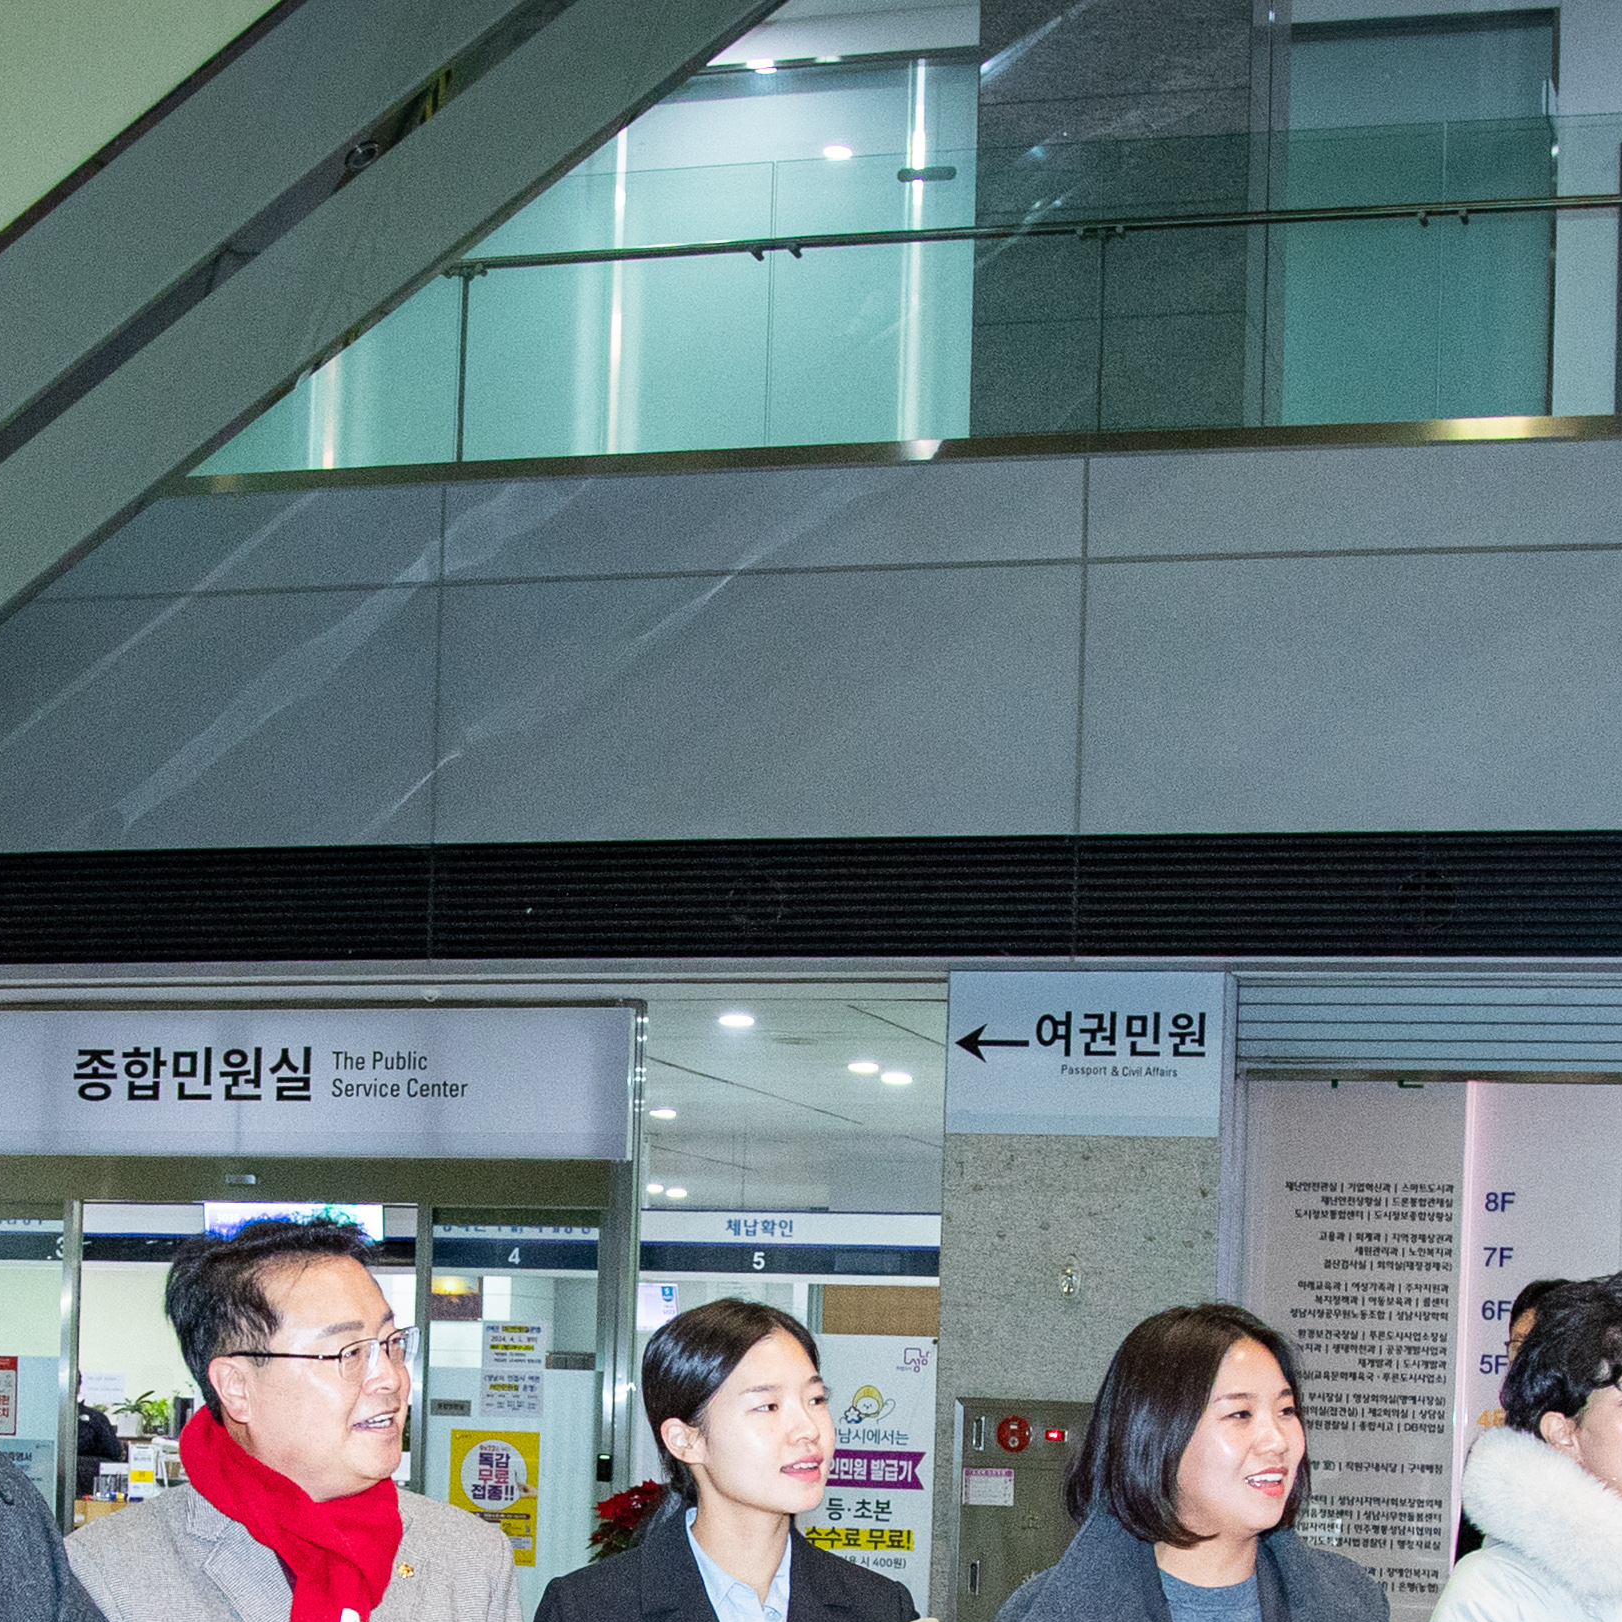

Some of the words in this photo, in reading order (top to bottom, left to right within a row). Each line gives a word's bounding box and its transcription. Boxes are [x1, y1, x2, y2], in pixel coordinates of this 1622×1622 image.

[1035, 1010, 1206, 1057] 여권민원
[332, 1050, 364, 1071] The
[371, 1050, 429, 1072] Public
[1061, 1064, 1107, 1077] Passport
[1110, 1066, 1119, 1076] &
[1122, 1066, 1142, 1077] Civil
[1145, 1066, 1178, 1078] Affairs
[74, 1046, 313, 1102] 종합민원실
[331, 1077, 400, 1099] Service
[406, 1077, 469, 1099] Center
[1485, 1192, 1516, 1212] 8F
[726, 1218, 794, 1238] 체납확인
[507, 1247, 521, 1265] 4
[752, 1252, 765, 1270] 5
[1482, 1247, 1514, 1268] 7F
[1481, 1300, 1512, 1321] 6F
[1479, 1354, 1509, 1374] 5F
[834, 1428, 910, 1446] 남시에서는
[478, 1452, 511, 1469] 독감
[829, 1458, 867, 1482] 인민원
[870, 1459, 913, 1483] 발급기
[478, 1468, 510, 1486] 무료
[471, 1483, 515, 1501] 접종!!
[825, 1497, 893, 1522] 등·초본
[867, 1528, 912, 1550] 무료!
[860, 1557, 871, 1568] 시
